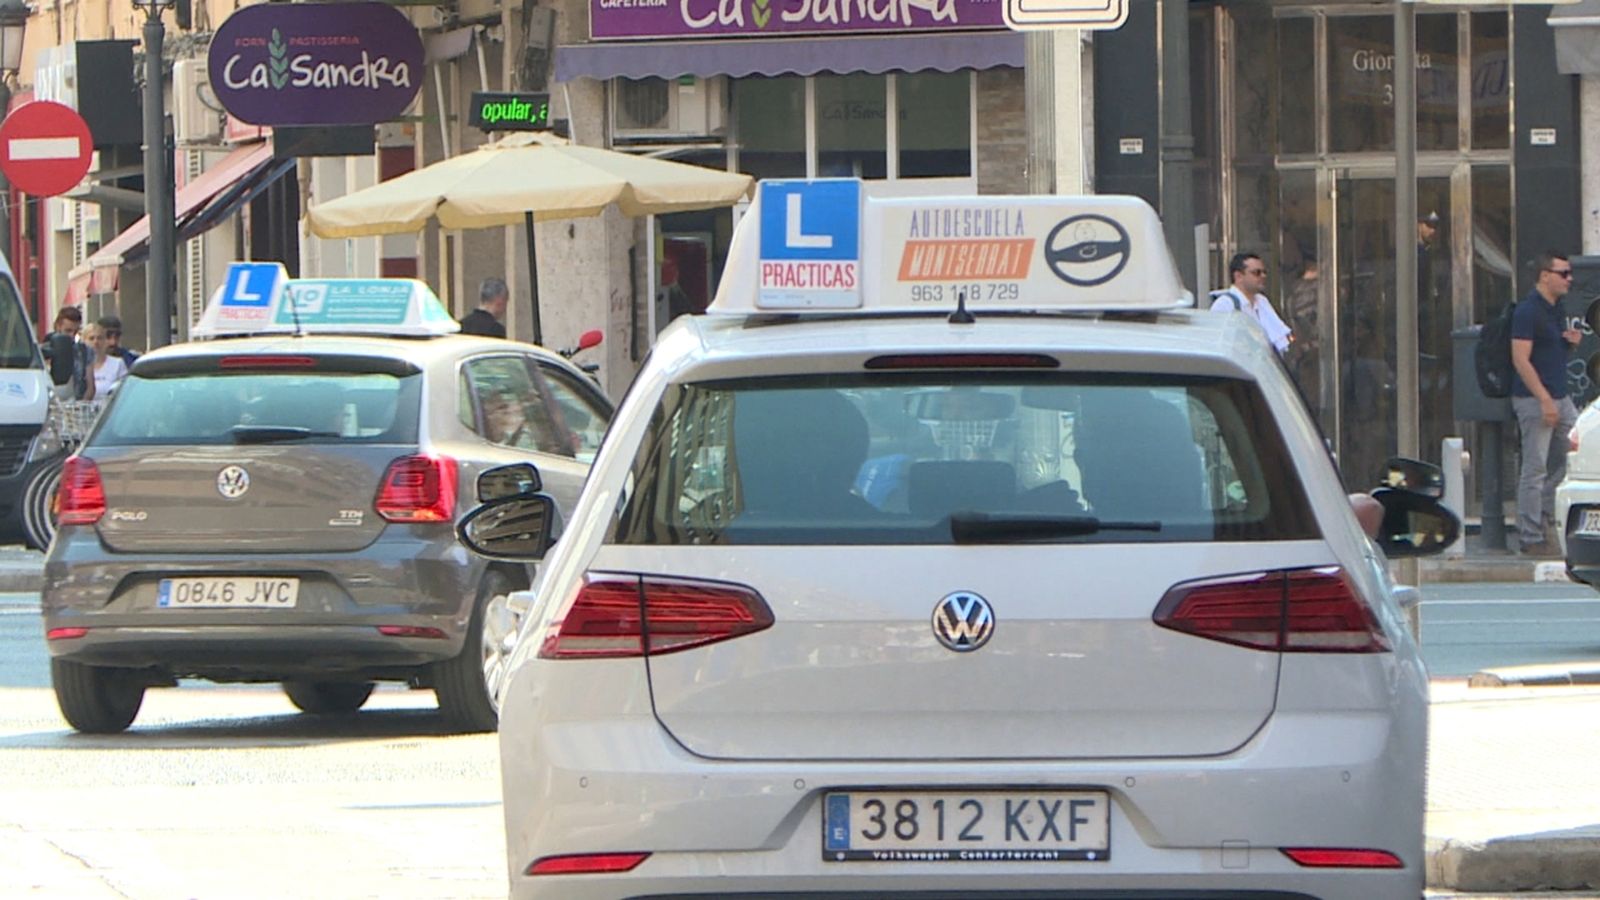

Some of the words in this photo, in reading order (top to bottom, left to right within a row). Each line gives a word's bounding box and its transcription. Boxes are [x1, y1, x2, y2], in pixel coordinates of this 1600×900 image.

[785, 192, 833, 248] L
[909, 208, 1025, 238] AUTOESCUELA
[908, 243, 1025, 277] MONTSERRAT
[234, 269, 261, 301] L
[762, 262, 855, 288] PRACTICAS
[911, 284, 944, 302] 963
[950, 284, 981, 301] 118
[987, 282, 1019, 301] 729
[111, 510, 148, 521] POLO
[175, 582, 236, 603] 0846
[245, 582, 290, 603] JVC
[861, 799, 984, 841] 3812
[1004, 799, 1096, 841] KXF
[873, 851, 950, 861] Volkswagen
